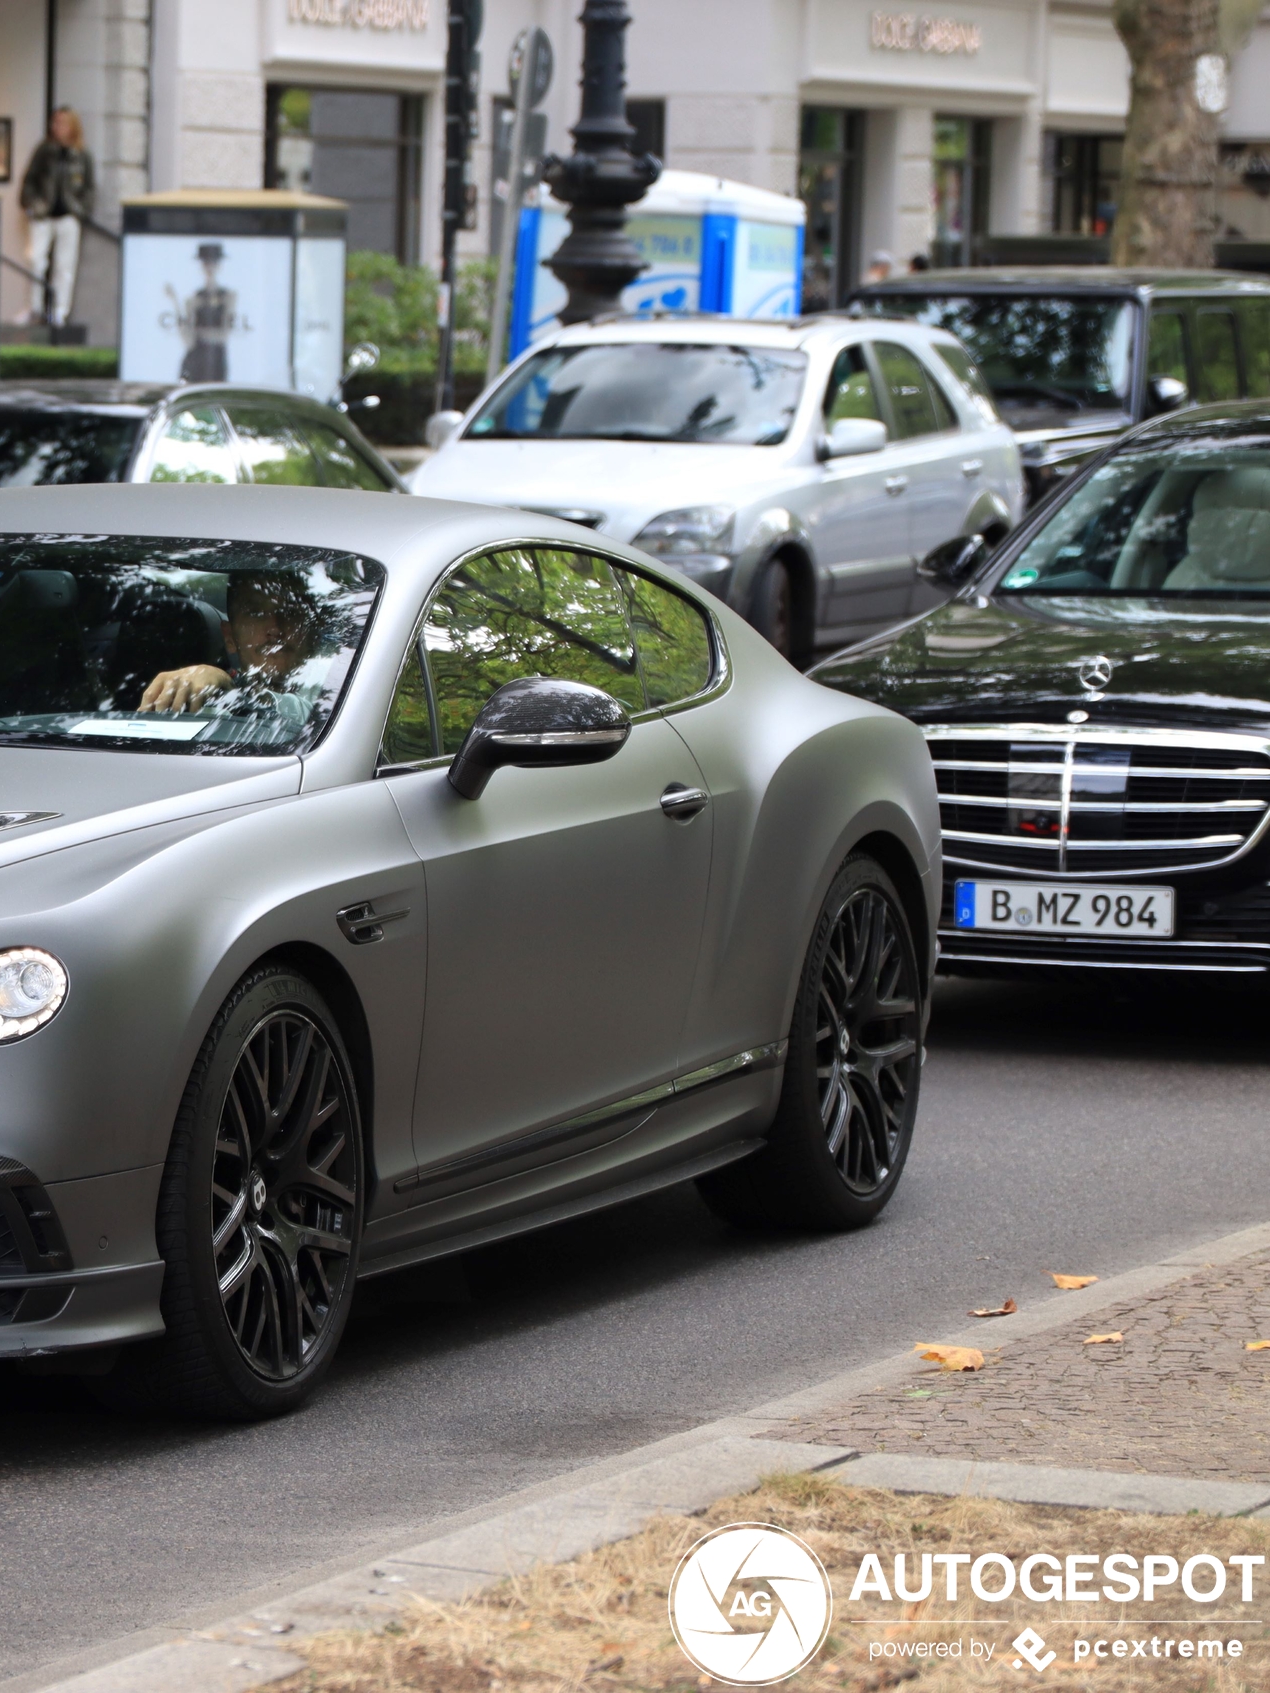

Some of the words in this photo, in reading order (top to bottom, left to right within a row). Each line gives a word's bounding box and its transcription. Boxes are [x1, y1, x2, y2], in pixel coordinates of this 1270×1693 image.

[991, 889, 1012, 922] B
[1036, 891, 1083, 926] MZ
[1090, 894, 1158, 929] 984
